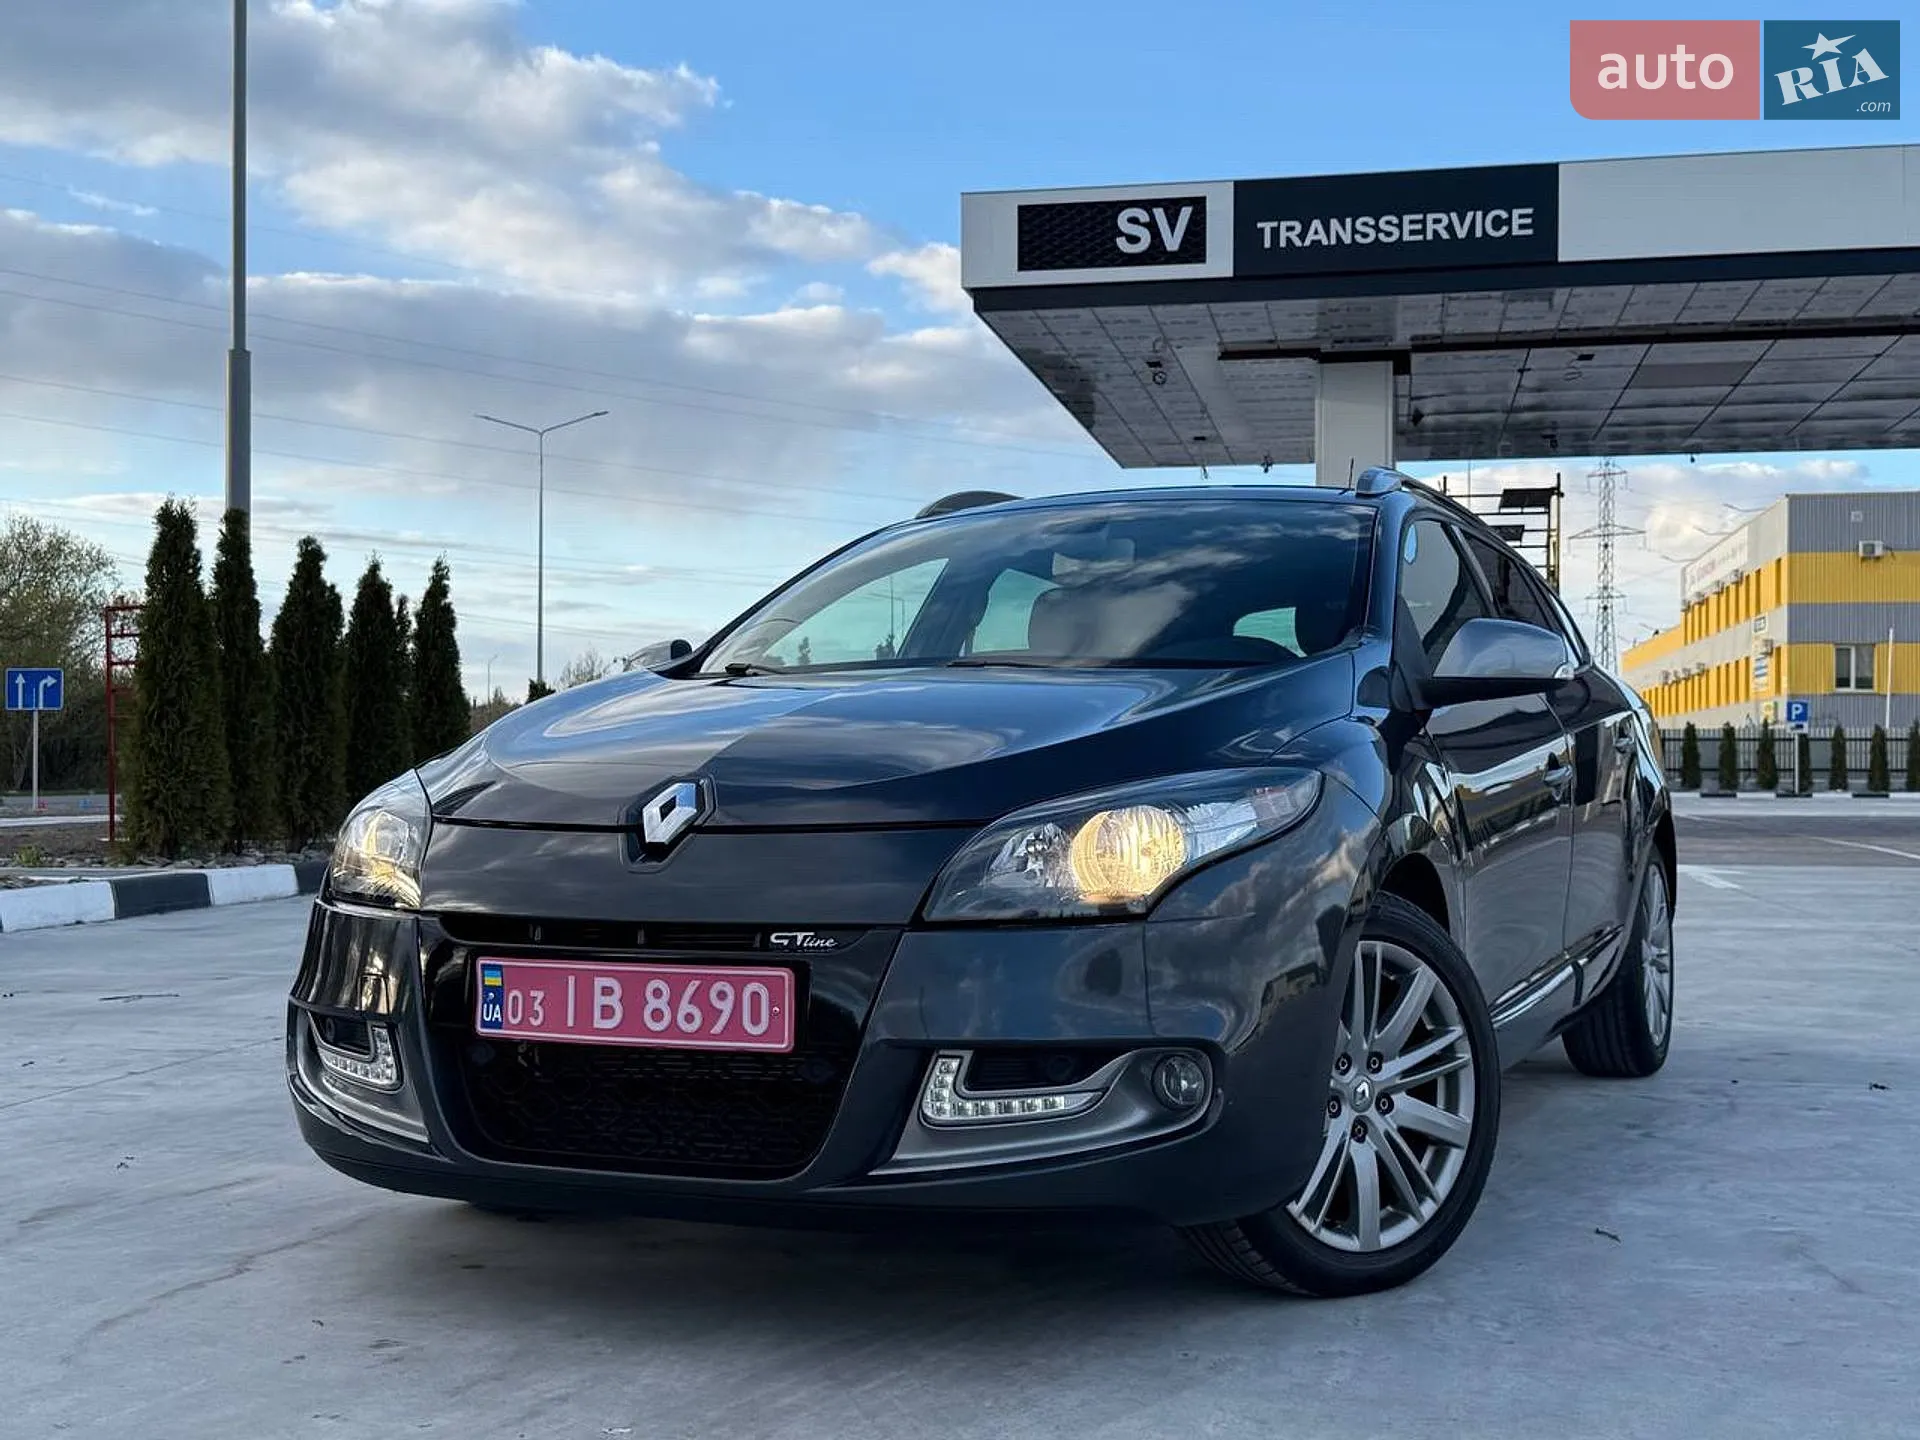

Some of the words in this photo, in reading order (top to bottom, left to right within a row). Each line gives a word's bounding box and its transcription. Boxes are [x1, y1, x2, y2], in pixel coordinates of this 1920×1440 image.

[1115, 205, 1194, 255] SV
[1257, 208, 1535, 249] TRANSSERVICE
[1791, 704, 1803, 720] P
[483, 1003, 502, 1022] UA
[508, 990, 545, 1026] 03
[643, 979, 770, 1036] 8690
